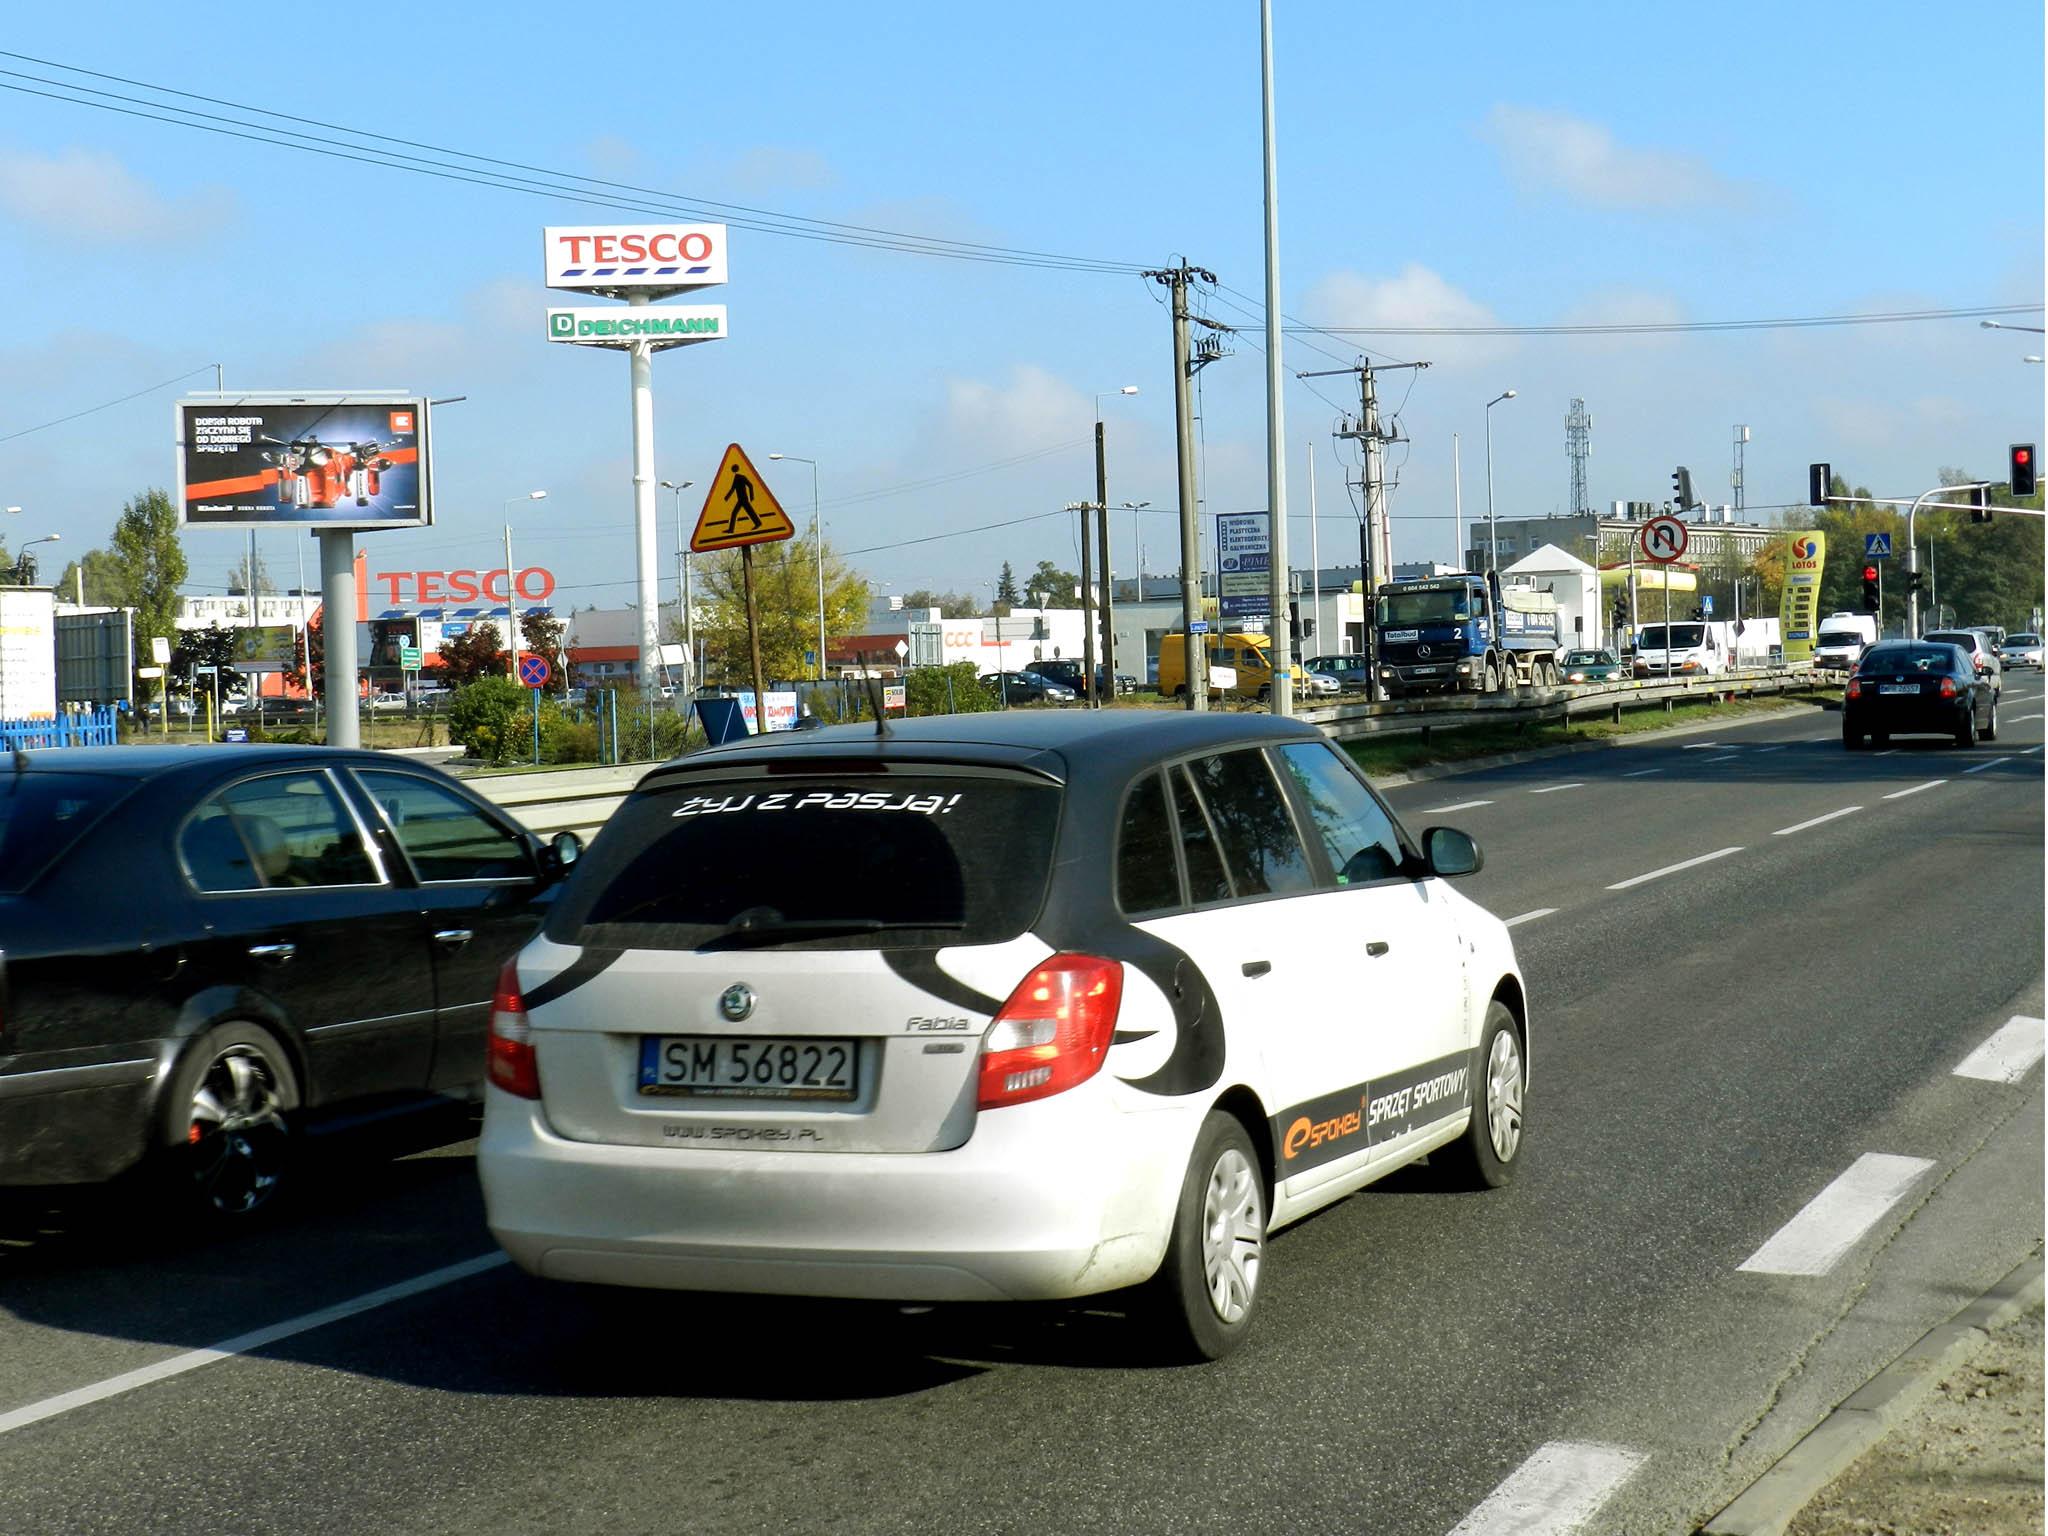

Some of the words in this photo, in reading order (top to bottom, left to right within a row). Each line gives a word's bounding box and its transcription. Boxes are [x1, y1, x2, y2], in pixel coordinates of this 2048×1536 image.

[560, 233, 713, 264] TESCO
[578, 318, 719, 336] DEICHMANN
[195, 417, 226, 426] DOBRA
[227, 417, 263, 425] ROBOTA
[196, 426, 236, 434] ZACZYNA
[238, 426, 251, 436] SIĘ
[210, 435, 252, 443] DOBREGO
[1792, 560, 1816, 569] LOTOS
[377, 567, 555, 605] TESCO
[945, 632, 974, 648] CCC
[1386, 631, 1417, 639] Totalbud
[1454, 628, 1462, 640] 2
[905, 1016, 969, 1031] Fabia
[664, 1043, 716, 1082] SM
[729, 1043, 846, 1086] 56822
[1368, 1087, 1412, 1127] SPRZĘT
[1412, 1067, 1467, 1108] SPORTOWY
